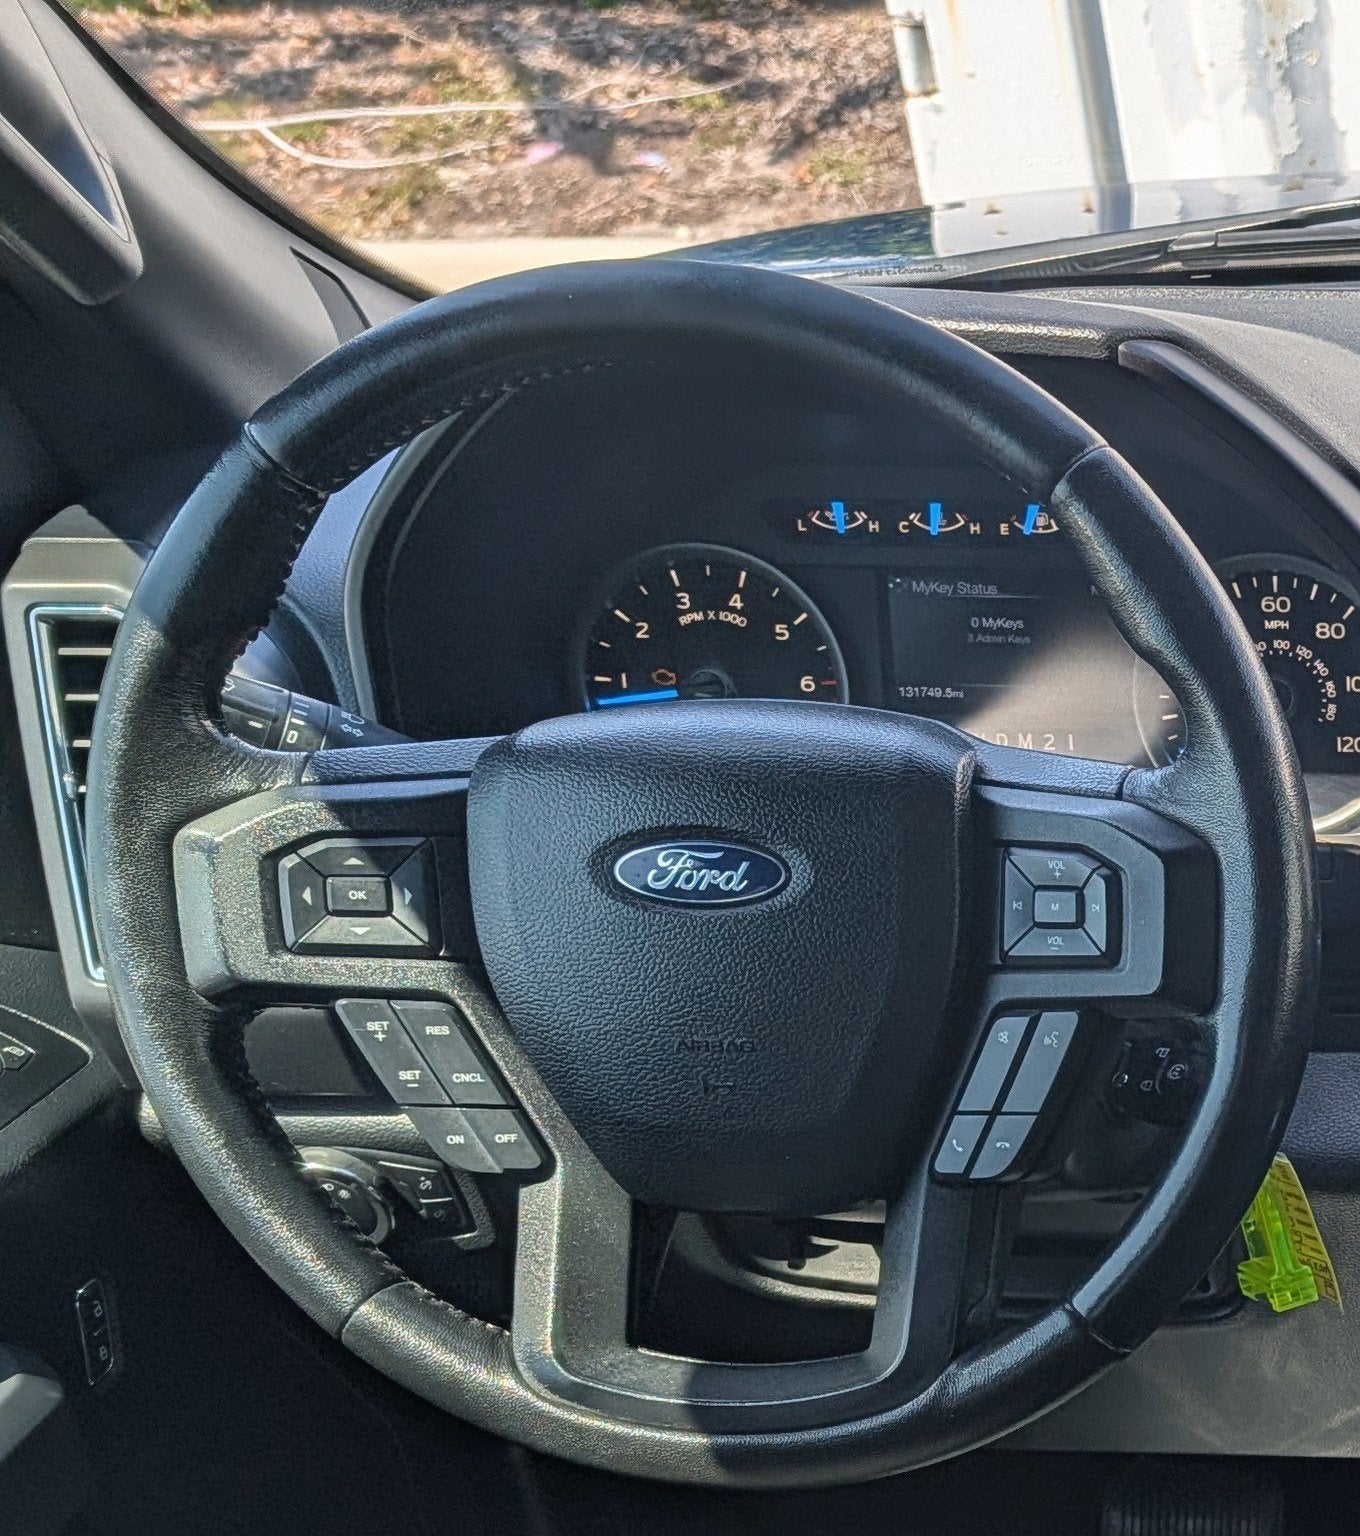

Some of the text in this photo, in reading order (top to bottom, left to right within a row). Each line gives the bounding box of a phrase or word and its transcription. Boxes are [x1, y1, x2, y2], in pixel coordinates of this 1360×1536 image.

[797, 519, 807, 532] L
[869, 521, 880, 533] H
[899, 521, 910, 533] C
[970, 523, 981, 535] H
[1000, 523, 1010, 535] E
[912, 580, 998, 596] MyKey Status
[676, 592, 691, 610] 3
[728, 593, 744, 611] 4
[1261, 596, 1291, 613] 60
[678, 611, 704, 627] RPM
[719, 610, 748, 628] 1000
[982, 617, 1024, 630] MyKeys
[1264, 620, 1289, 630] MPH
[635, 622, 650, 639] 2
[774, 624, 789, 642] 5
[1315, 622, 1345, 640] 80
[1273, 639, 1290, 650] 100
[1295, 644, 1312, 660] 120
[1313, 658, 1329, 677] 140
[800, 675, 816, 693] 6
[1044, 733, 1056, 750] 2
[647, 849, 749, 891] Ford
[1047, 859, 1065, 870] VOL
[349, 889, 367, 900] OK
[1051, 902, 1059, 911] M
[1047, 936, 1064, 945] VOL
[366, 1021, 389, 1031] SET
[426, 1025, 449, 1035] RES
[399, 1070, 420, 1080] SET
[453, 1073, 485, 1083] CNCL
[447, 1135, 465, 1145] ON
[495, 1134, 518, 1144] OFF
